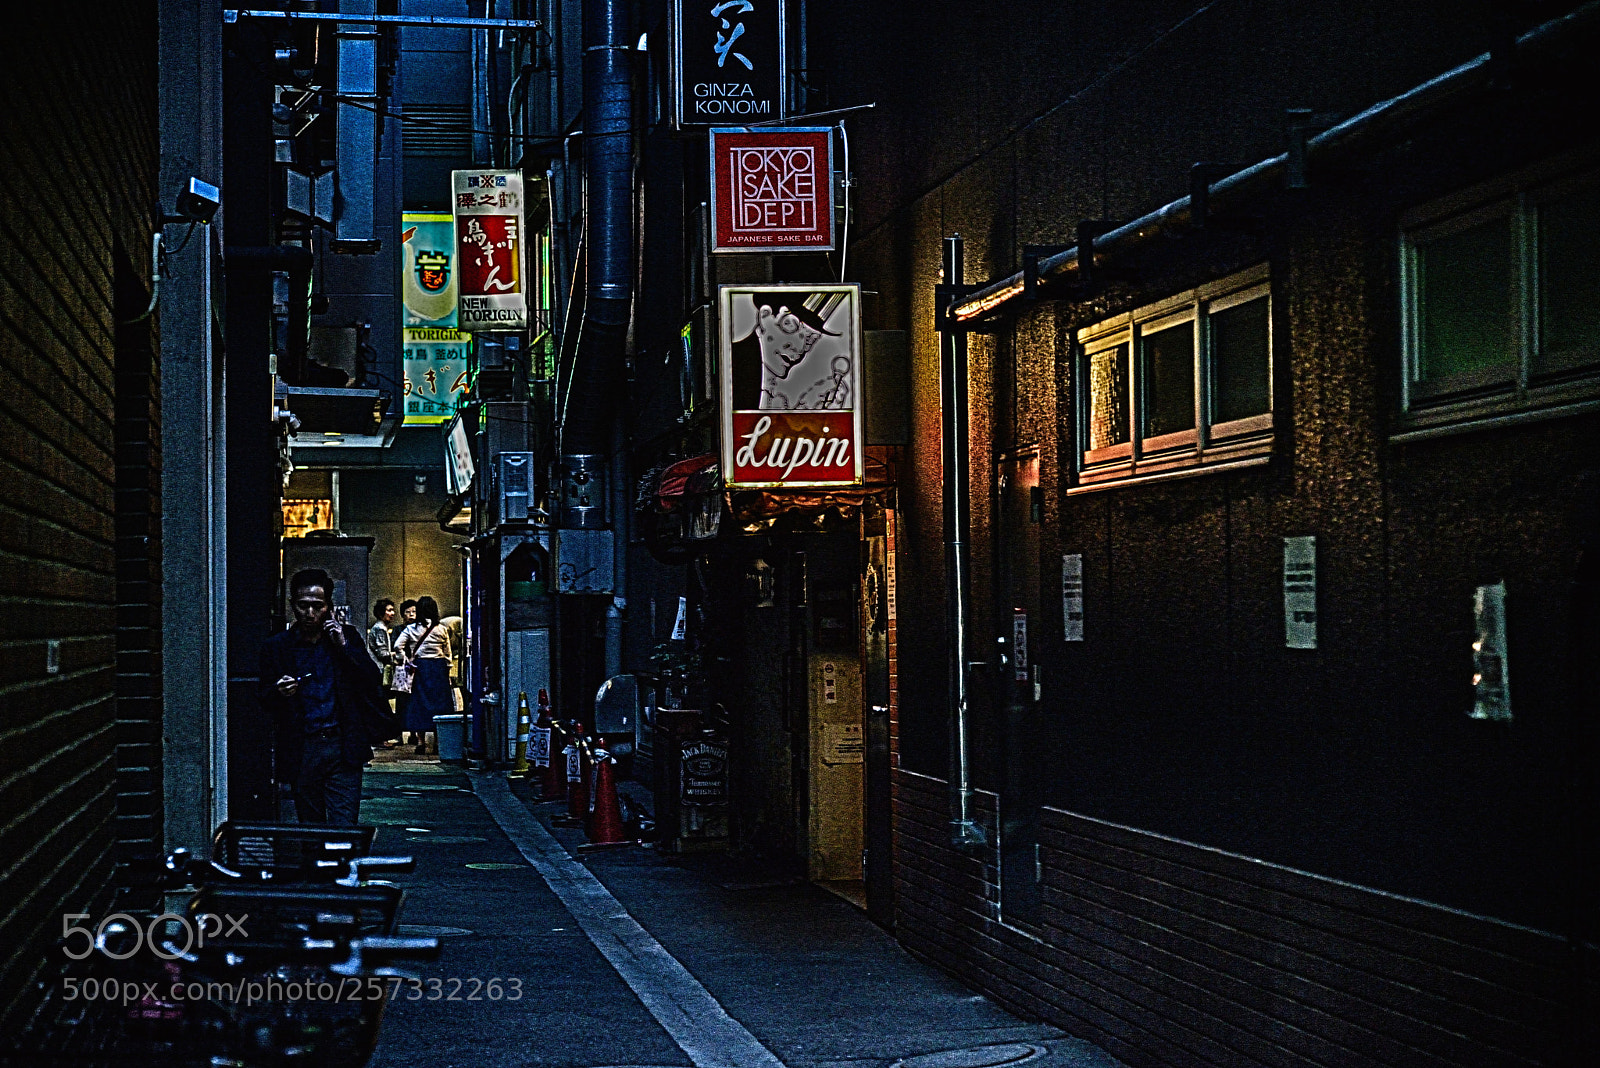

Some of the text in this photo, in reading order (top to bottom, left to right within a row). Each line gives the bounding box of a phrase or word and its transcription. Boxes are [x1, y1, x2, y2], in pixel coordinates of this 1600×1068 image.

[693, 83, 754, 97] GINZA
[695, 100, 770, 114] KONOMI
[730, 147, 814, 173] TOKYO
[744, 174, 813, 199] SAKE
[743, 200, 813, 226] DEPT
[504, 219, 518, 250] ニュー
[727, 234, 773, 243] JAPANESE
[805, 234, 824, 242] BAR
[463, 218, 516, 292] 鳥ぎん
[462, 297, 489, 309] NEW
[462, 310, 523, 323] TORIGIN
[409, 330, 462, 340] TORIGIN
[435, 349, 467, 360] 釜めし
[736, 415, 850, 479] Lupin
